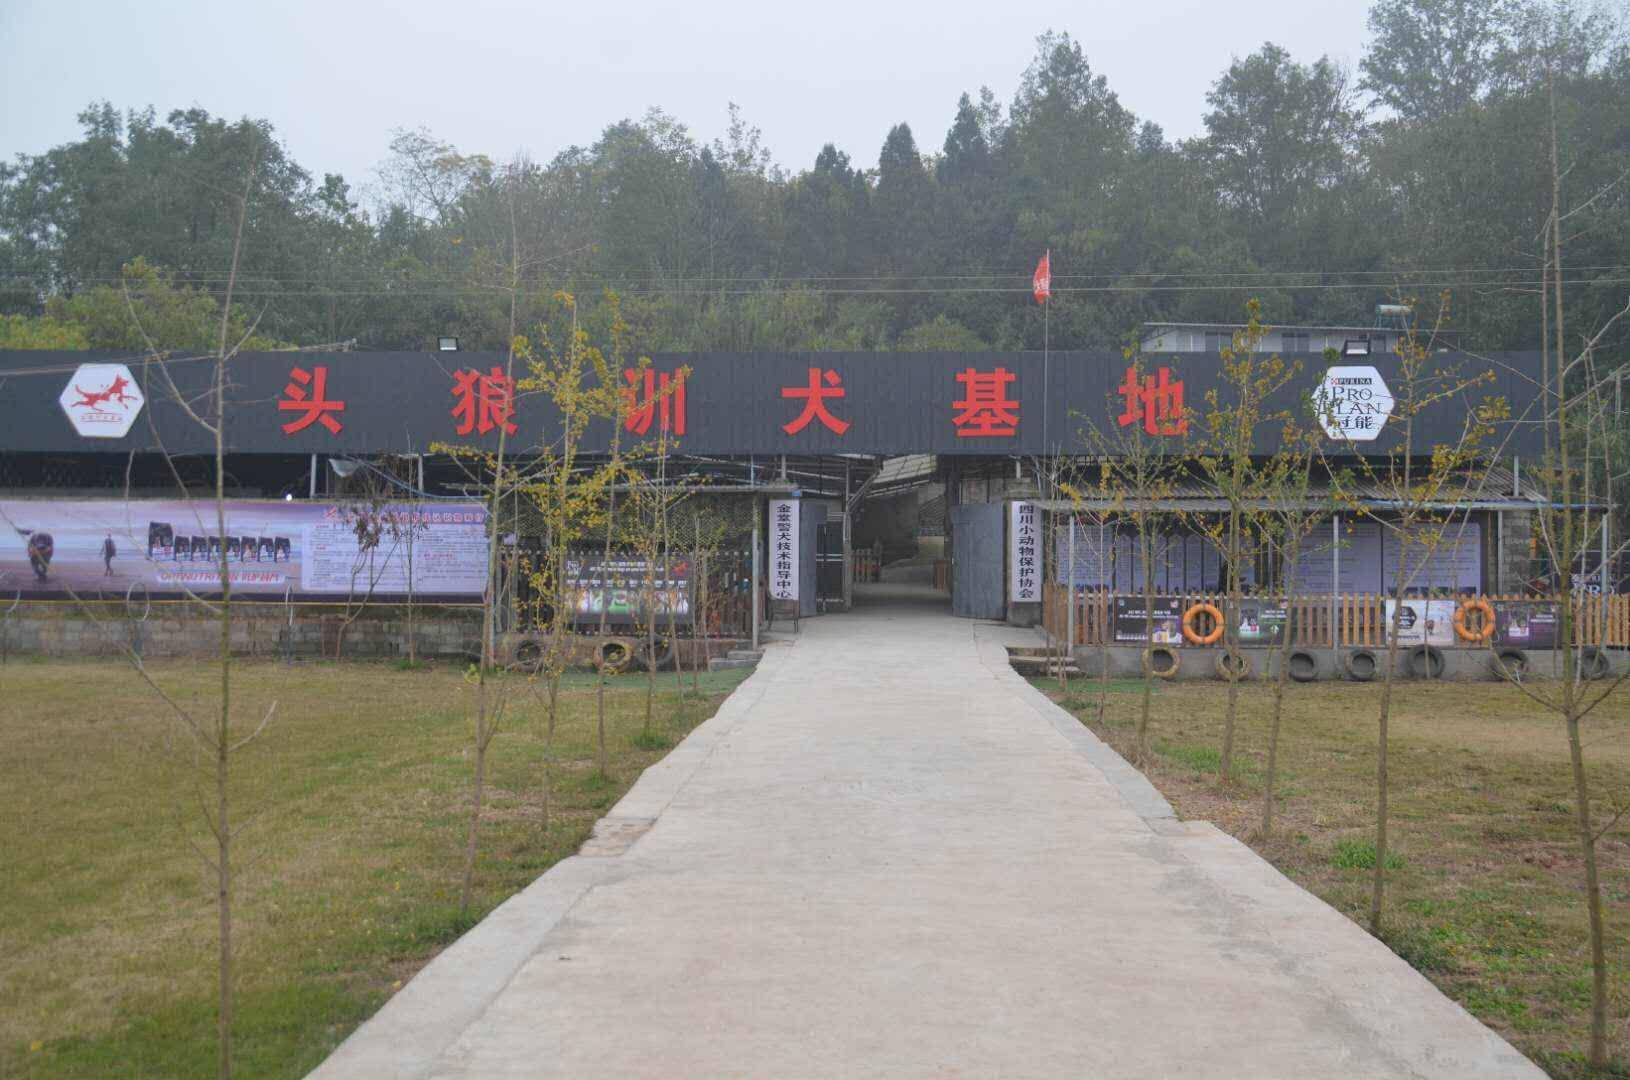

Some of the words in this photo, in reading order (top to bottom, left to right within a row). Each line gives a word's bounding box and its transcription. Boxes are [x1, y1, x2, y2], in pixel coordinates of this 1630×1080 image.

[1332, 386, 1373, 401] PRO
[776, 503, 792, 599] 金堂警犬技术指导中心
[1018, 504, 1035, 599] 四川小动物保护协会
